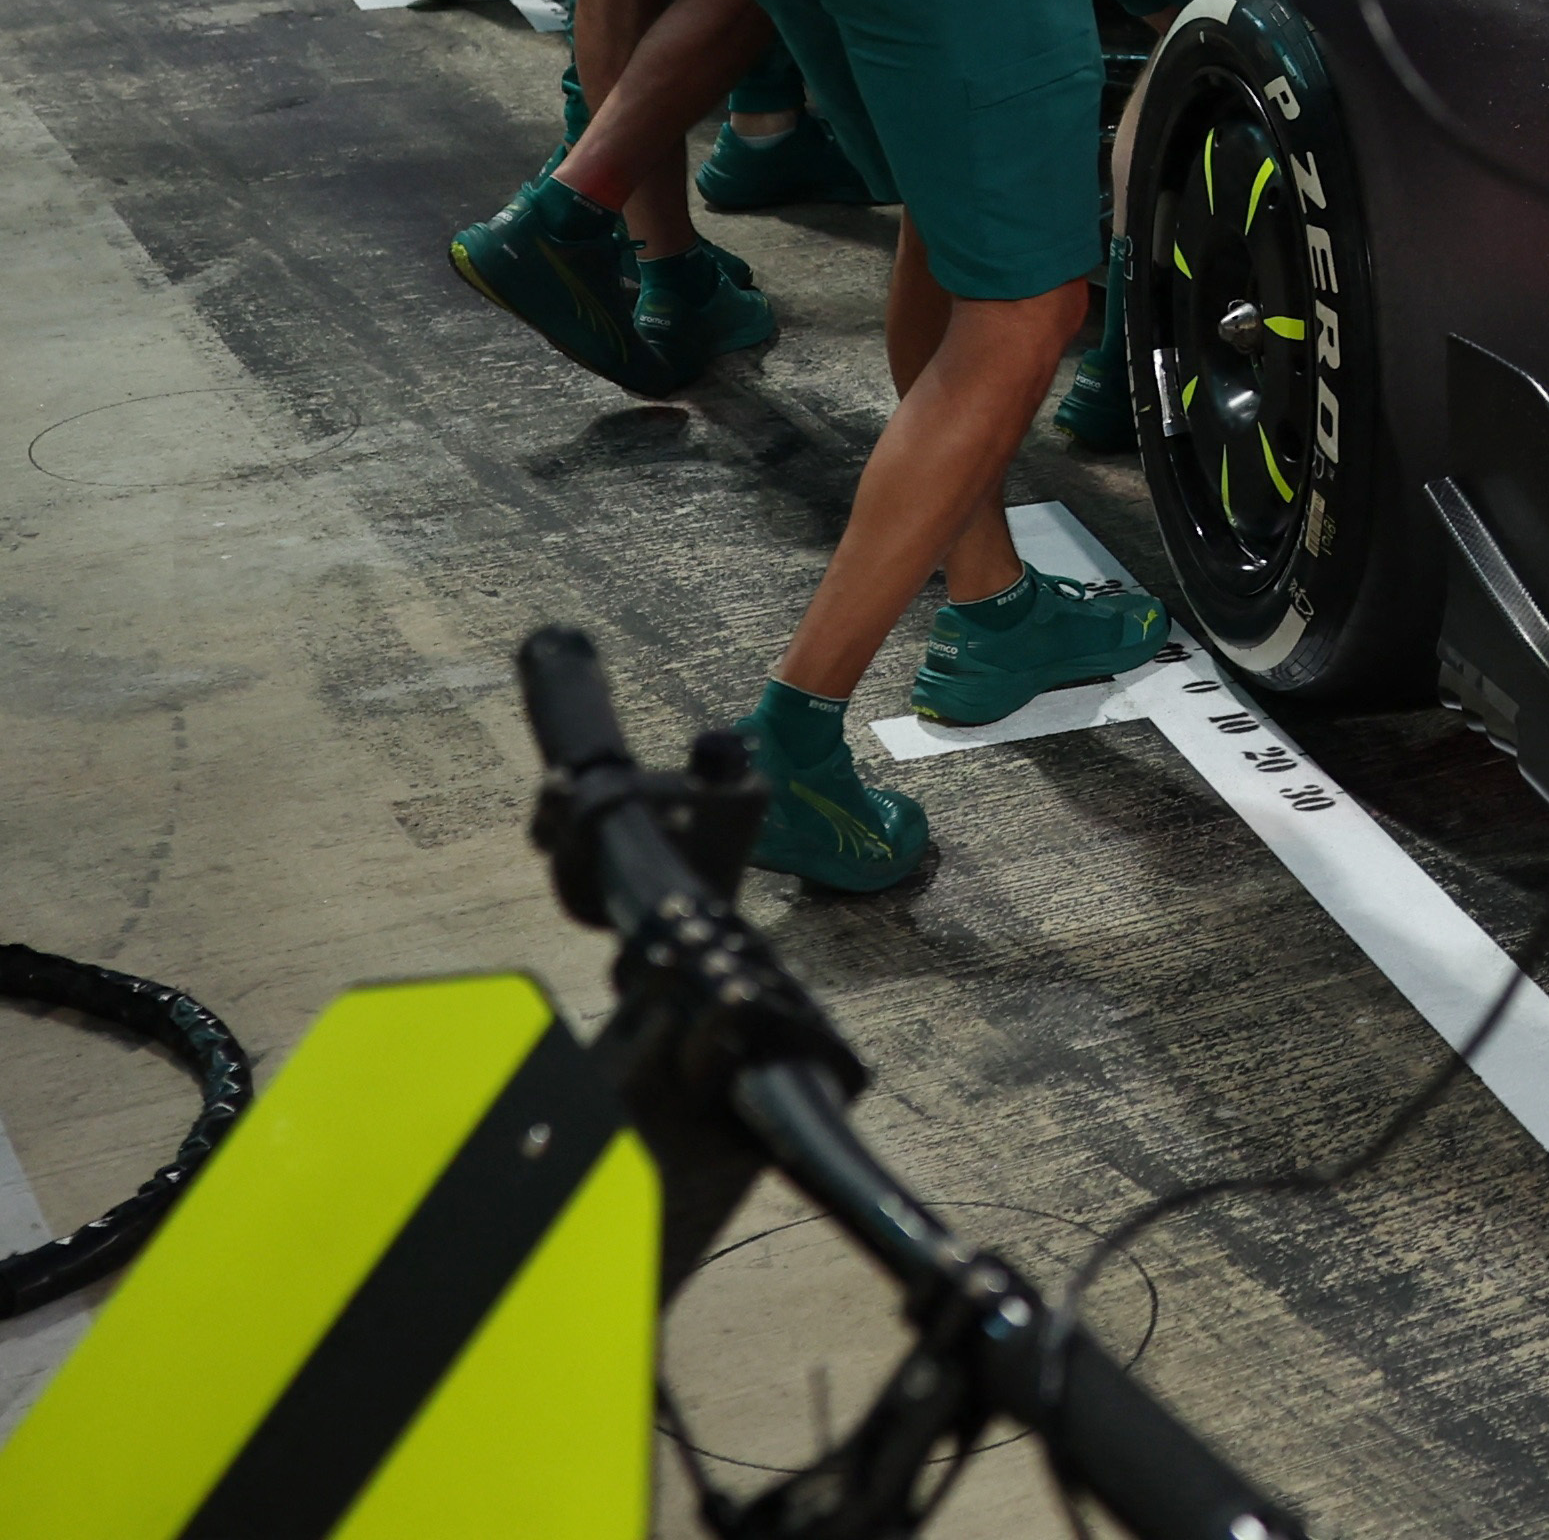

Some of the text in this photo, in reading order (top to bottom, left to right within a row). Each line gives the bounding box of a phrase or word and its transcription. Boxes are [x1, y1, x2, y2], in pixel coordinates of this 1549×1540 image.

[1262, 74, 1341, 464] P ZERO
[1207, 711, 1261, 735] 10
[1241, 745, 1299, 774] 20
[1278, 783, 1337, 812] 30
